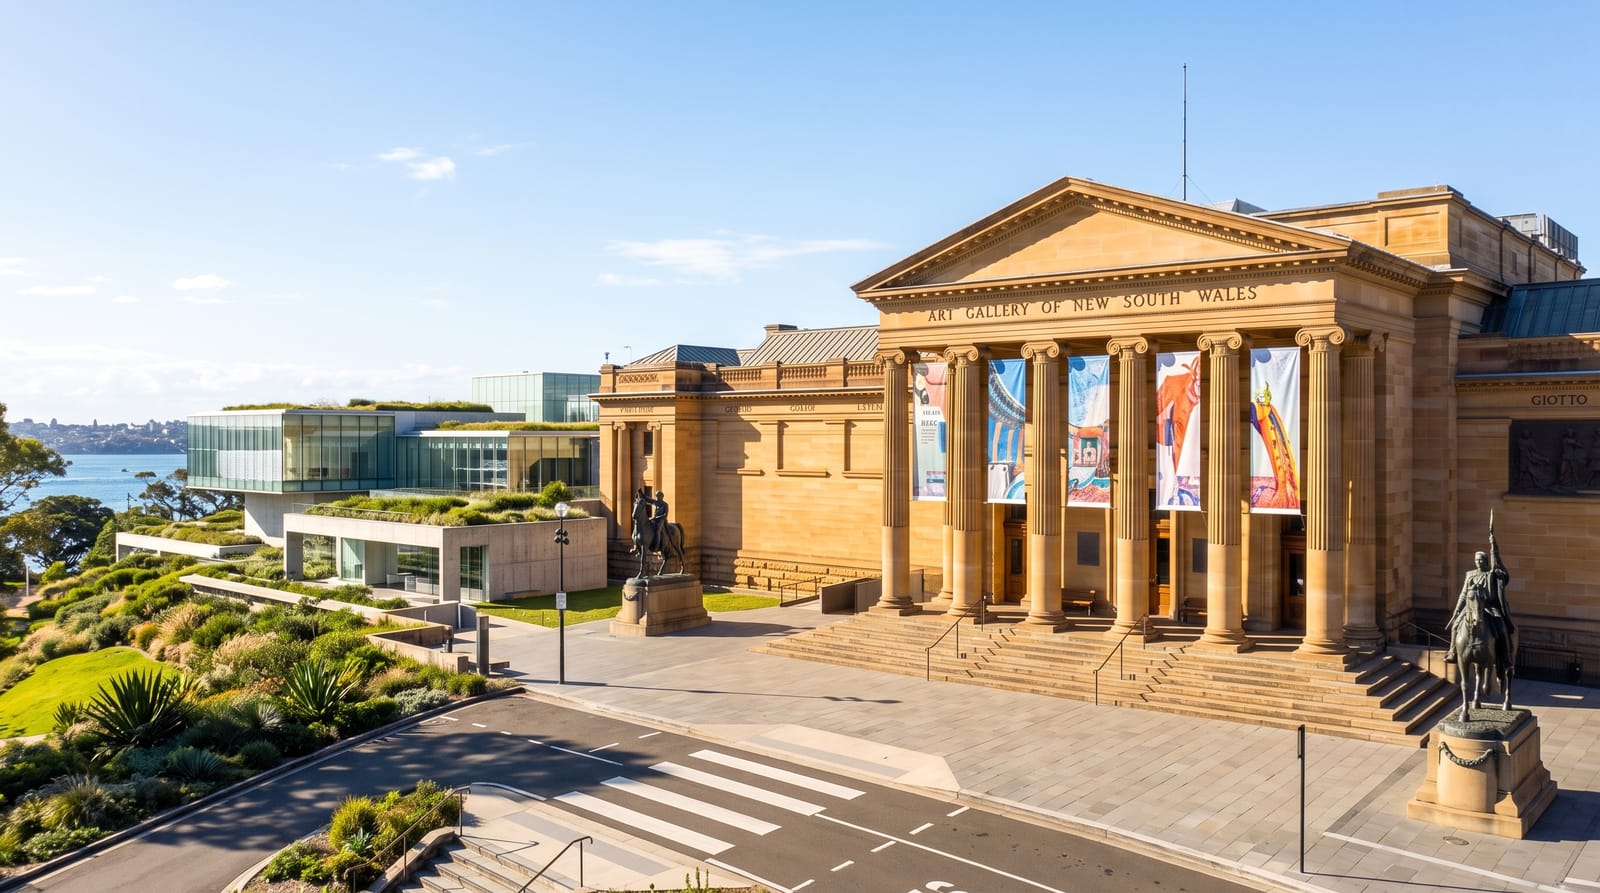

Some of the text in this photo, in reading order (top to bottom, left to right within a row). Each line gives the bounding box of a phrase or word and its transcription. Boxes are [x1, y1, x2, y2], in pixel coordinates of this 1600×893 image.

[928, 286, 1257, 322] ART GALLERY OF NEW SOUTH WALES
[1531, 394, 1588, 406] GIOTTO
